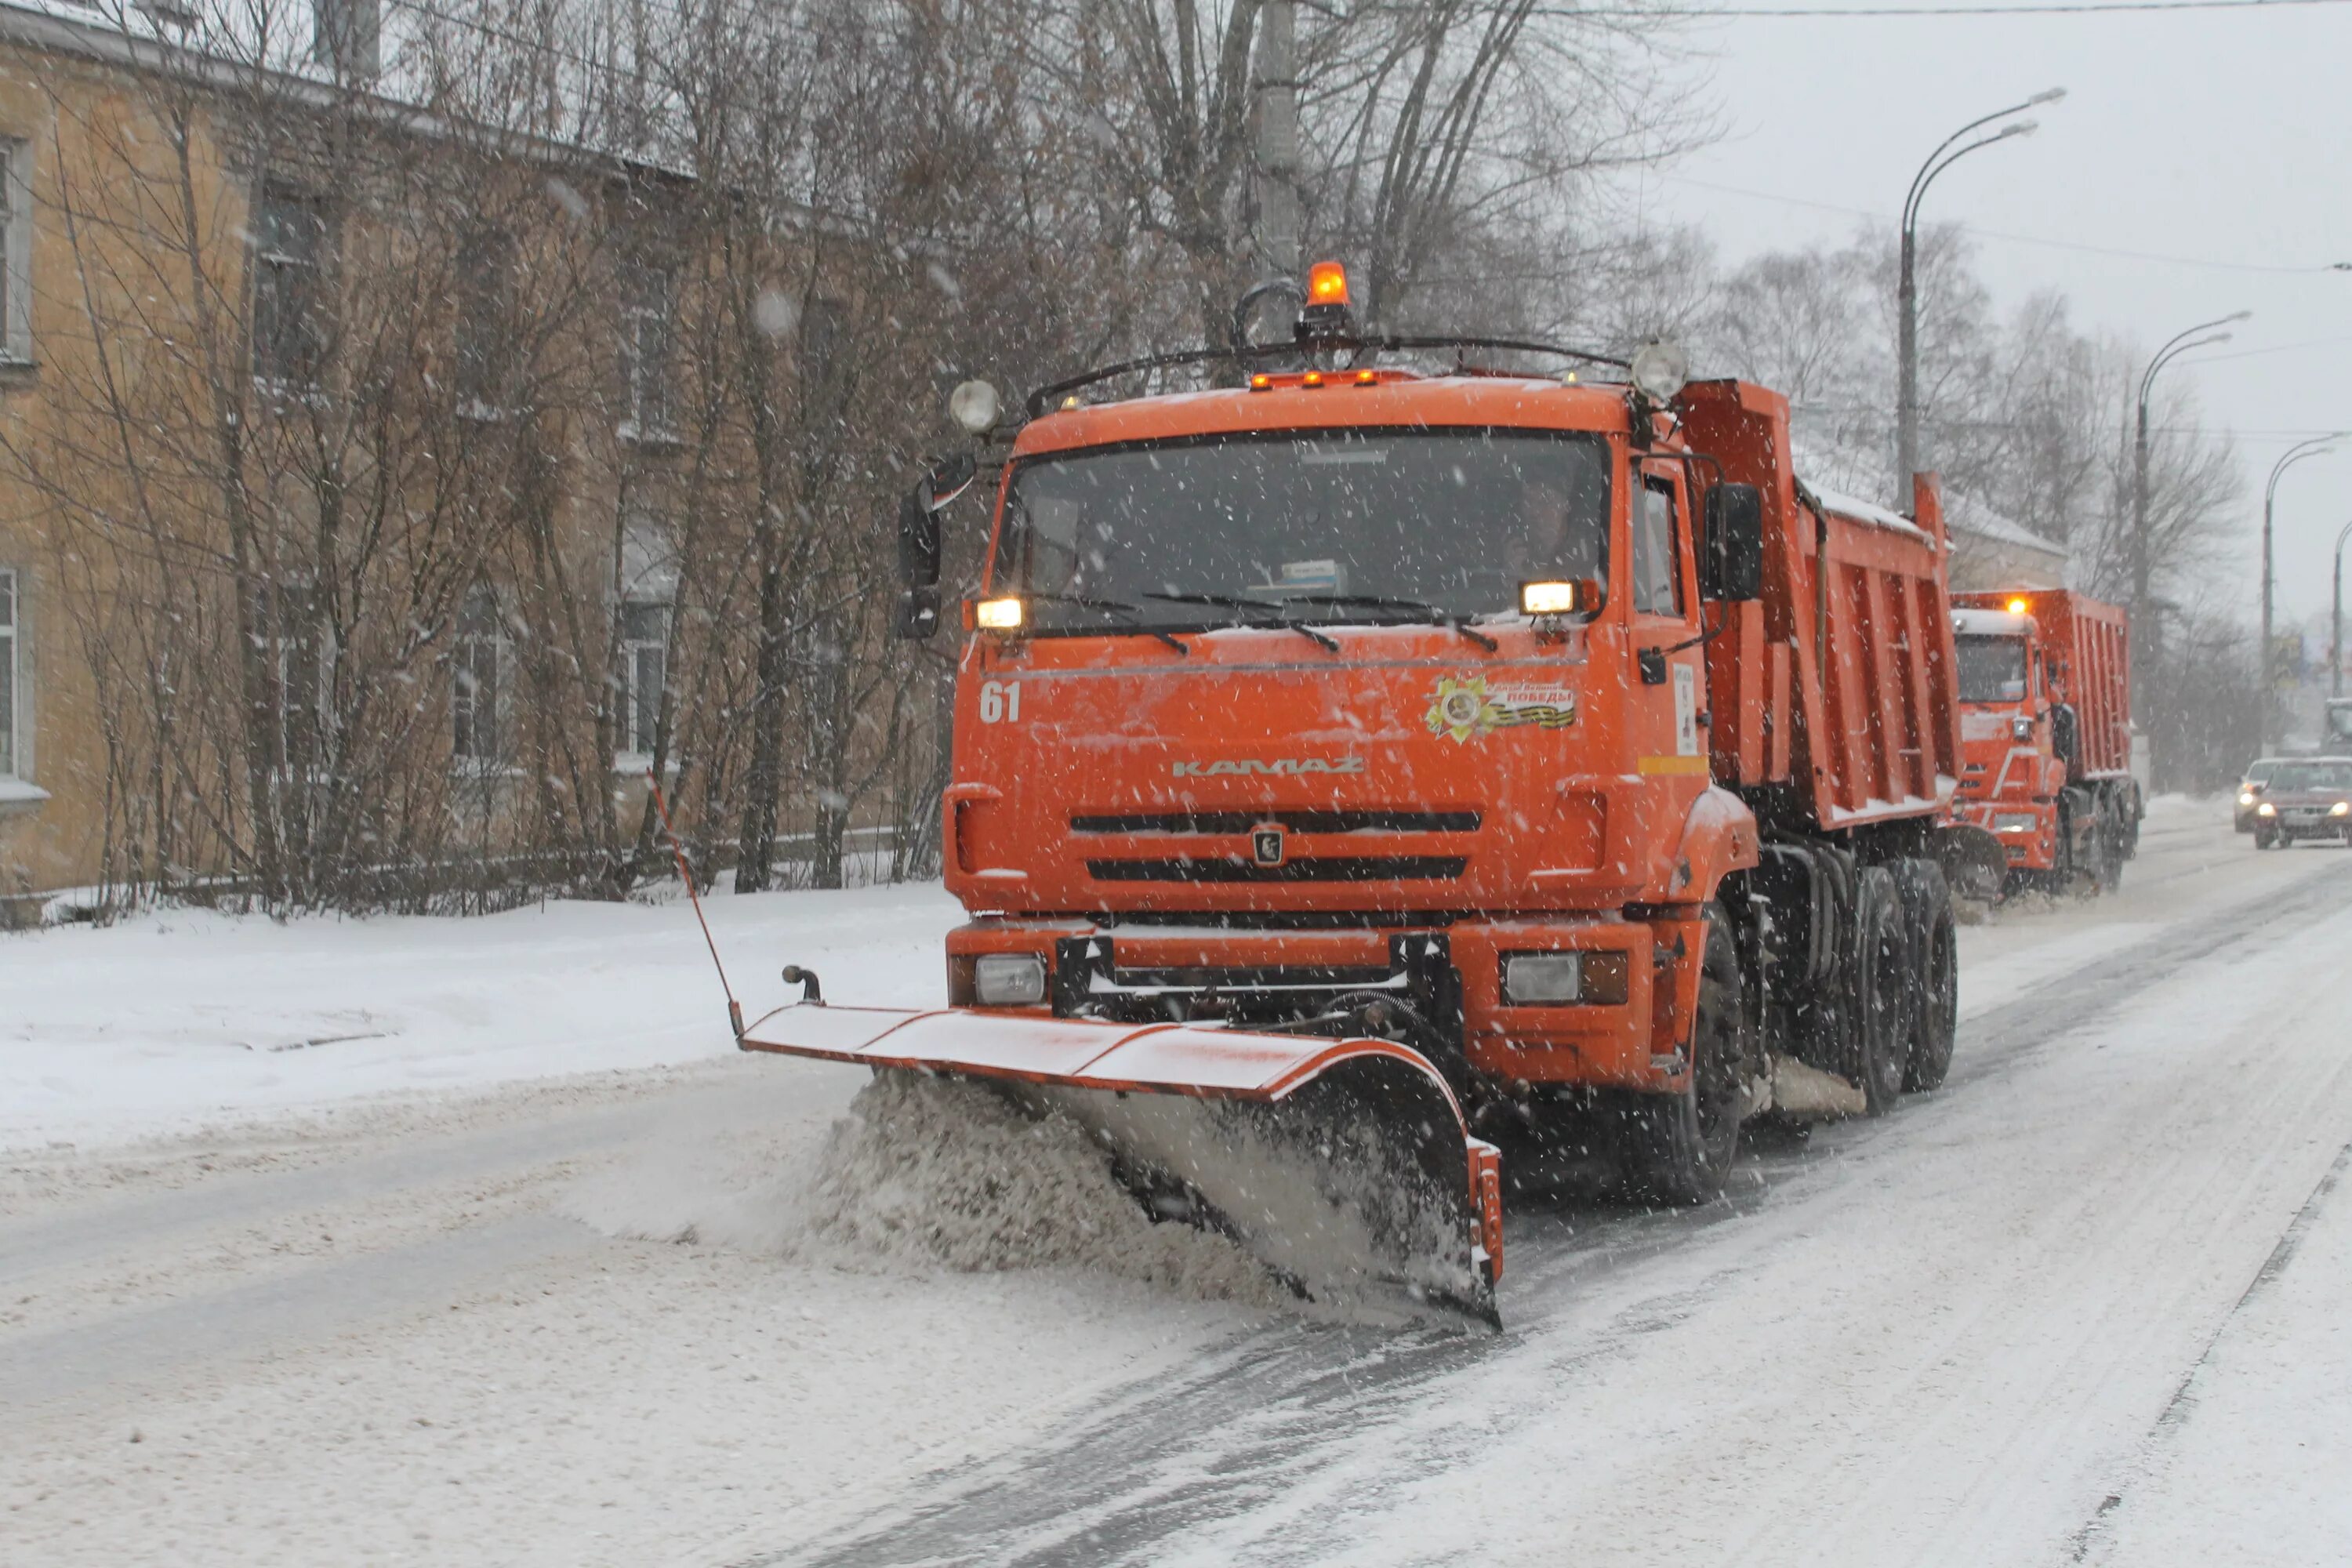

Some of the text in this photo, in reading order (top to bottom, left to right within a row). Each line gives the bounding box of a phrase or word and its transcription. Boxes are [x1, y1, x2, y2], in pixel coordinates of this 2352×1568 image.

[980, 683, 1021, 724] 61
[1506, 691, 1573, 704] ПОБЕДЫ
[1172, 757, 1364, 778] KAMAZ
